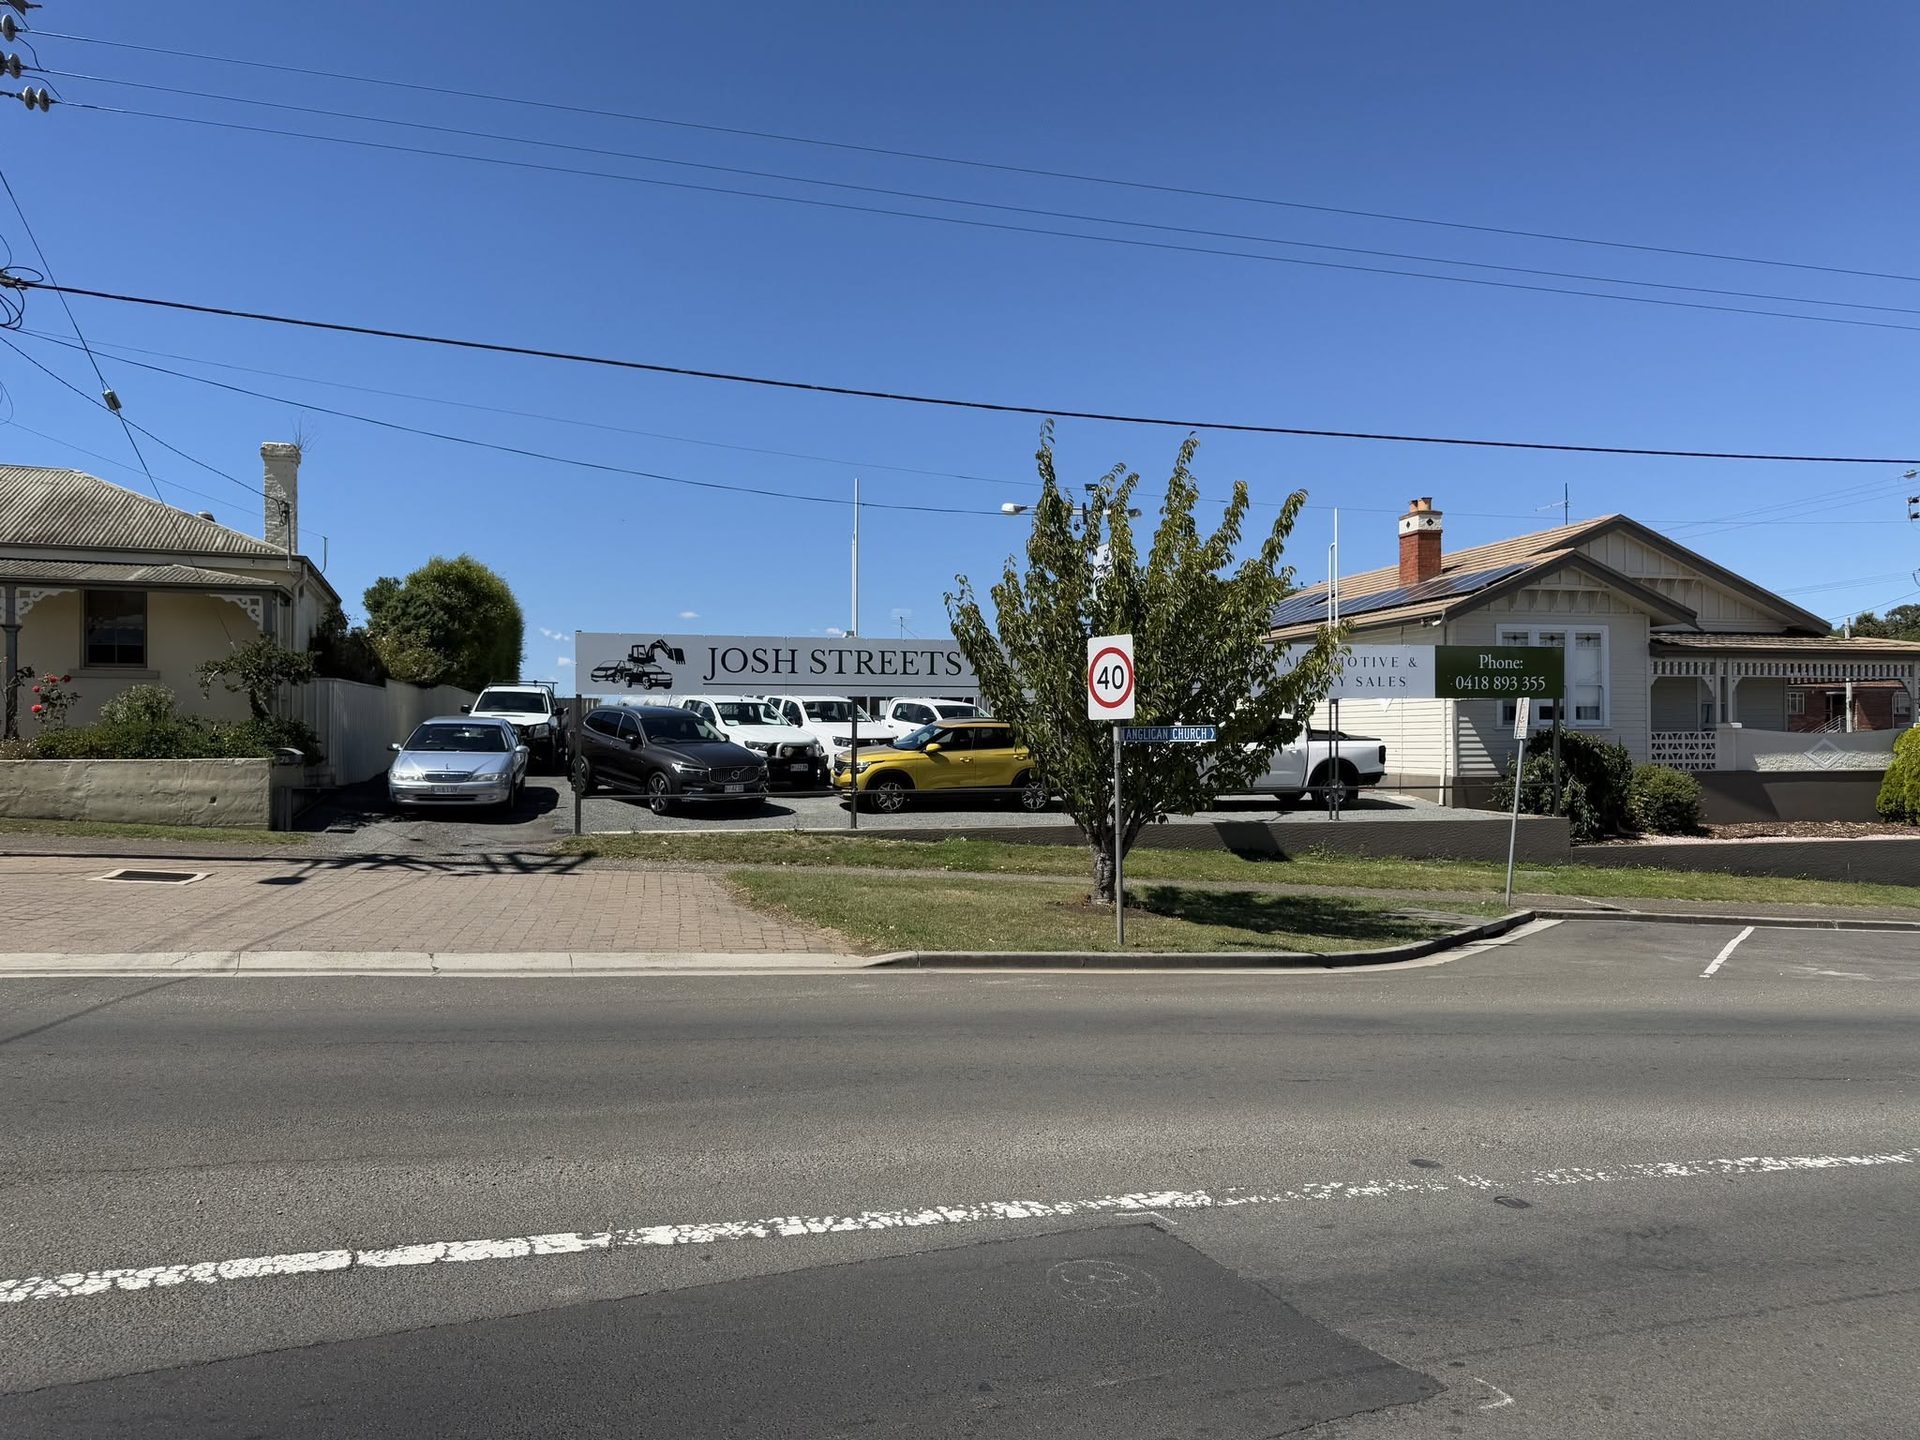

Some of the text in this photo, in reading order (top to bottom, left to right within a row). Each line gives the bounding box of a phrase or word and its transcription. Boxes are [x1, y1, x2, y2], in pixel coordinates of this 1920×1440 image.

[702, 647, 799, 681] JOSH
[809, 649, 962, 676] STREETS
[1283, 656, 1418, 668] AMOTIVE &
[1479, 654, 1523, 669] Phone:
[1096, 665, 1125, 690] 40
[1355, 676, 1407, 687] SALES
[1455, 674, 1546, 691] 0418 893 355
[1126, 727, 1207, 740] ANGLICAN CHURCH
